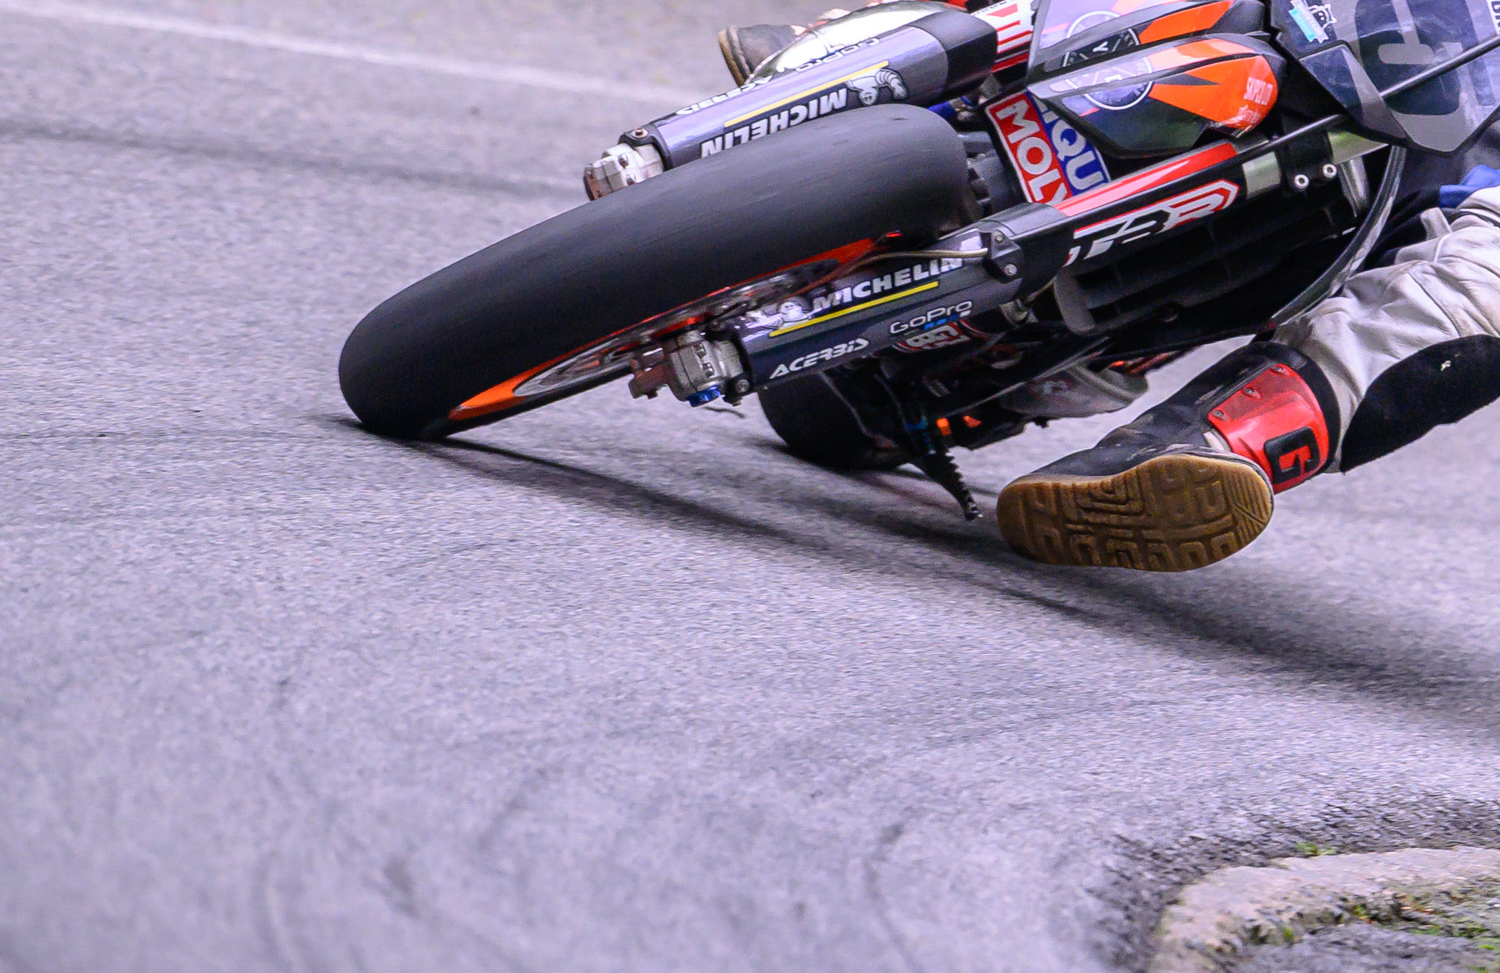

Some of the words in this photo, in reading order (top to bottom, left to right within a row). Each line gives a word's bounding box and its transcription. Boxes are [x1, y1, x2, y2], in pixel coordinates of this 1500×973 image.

[700, 87, 849, 159] MICHELIN
[812, 257, 964, 312] MICHELIN
[889, 299, 974, 336] GoPro
[768, 337, 871, 380] ACERBIS
